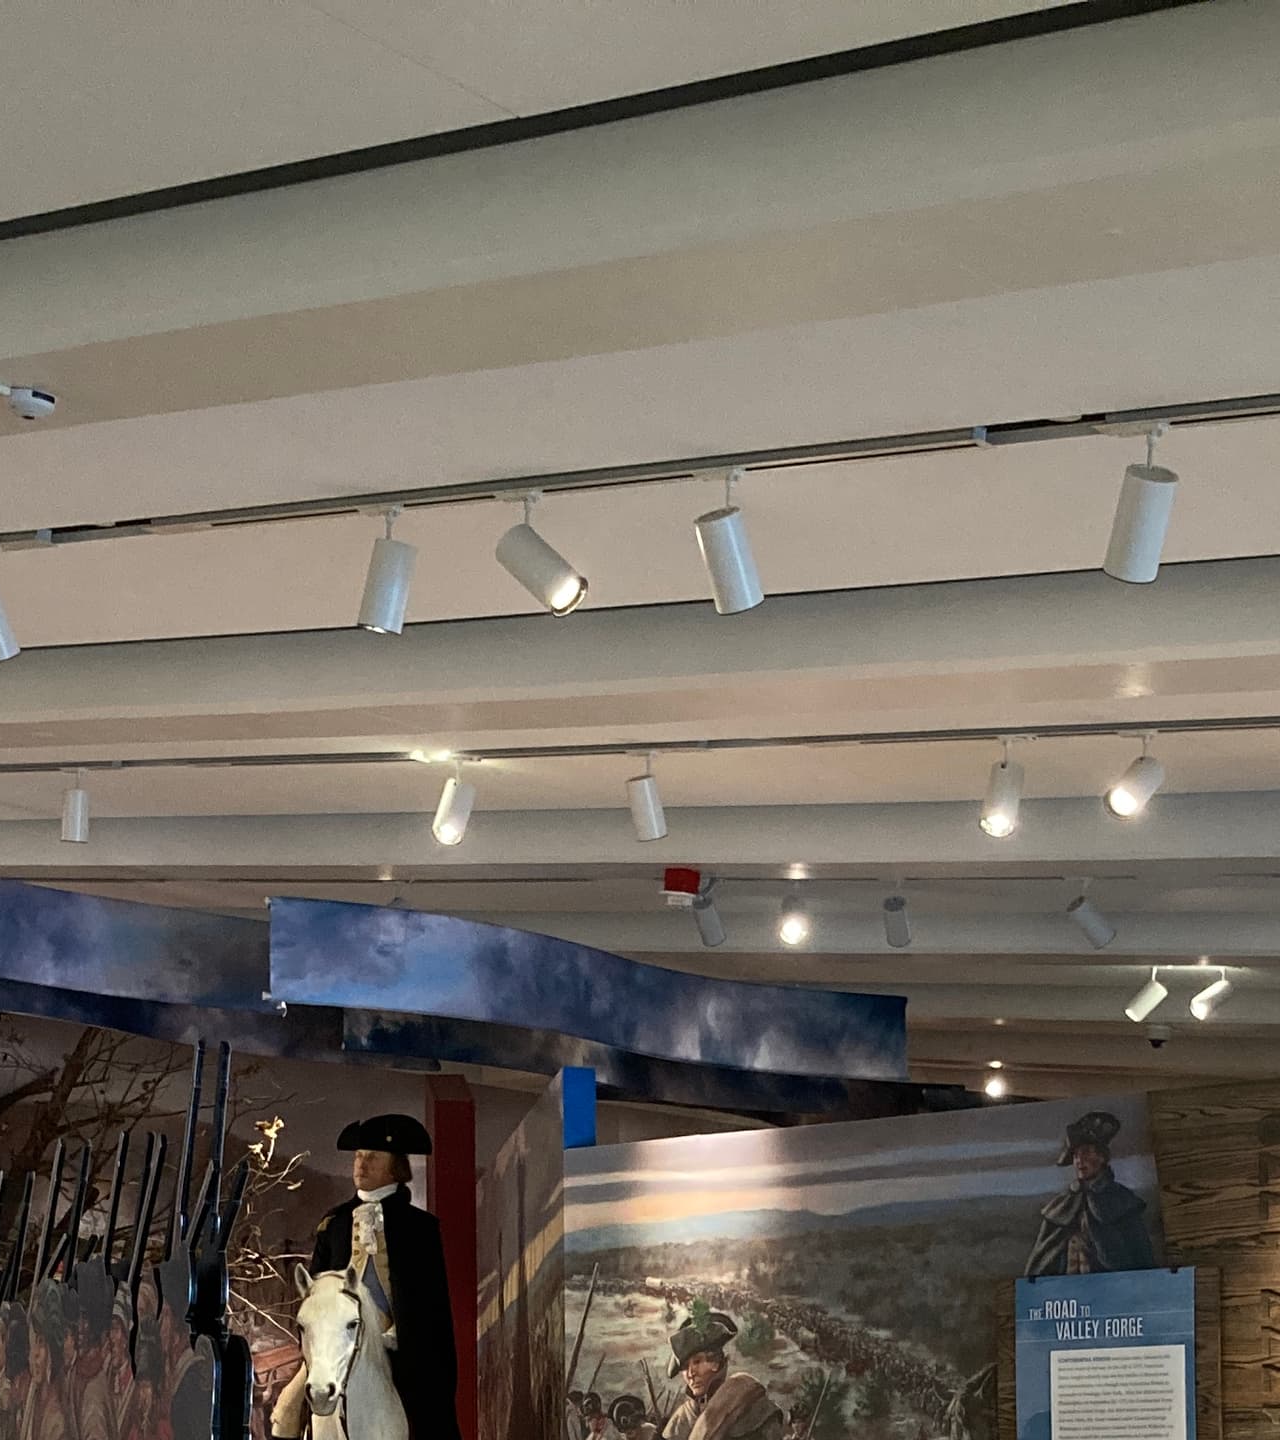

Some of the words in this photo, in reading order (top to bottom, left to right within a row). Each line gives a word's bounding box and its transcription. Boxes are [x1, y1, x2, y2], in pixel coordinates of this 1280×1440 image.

[1029, 1308, 1043, 1321] THE
[1045, 1300, 1077, 1320] ROAD
[1080, 1305, 1090, 1318] TO
[1056, 1319, 1099, 1341] VALLEY
[1105, 1317, 1144, 1338] FORGE
